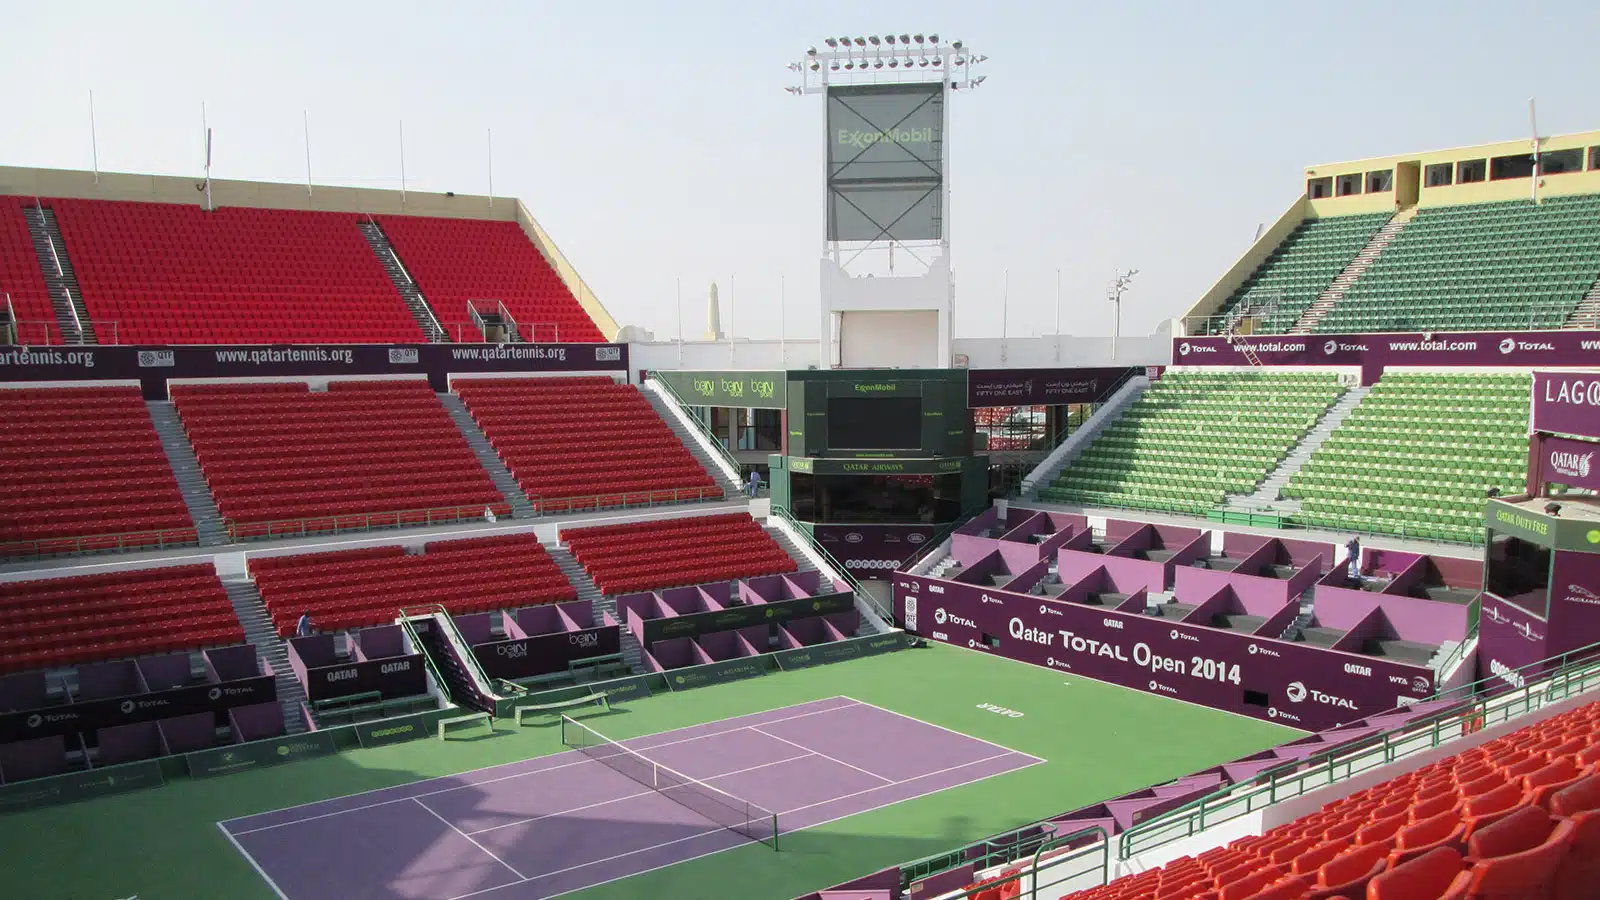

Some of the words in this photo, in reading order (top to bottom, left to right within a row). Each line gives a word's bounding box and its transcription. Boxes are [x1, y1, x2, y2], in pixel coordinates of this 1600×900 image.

[838, 127, 932, 151] ExxonMobil
[1233, 341, 1306, 352] www.total.com
[1338, 343, 1369, 351] TOTAL
[1388, 340, 1477, 351] www.total.com
[1517, 341, 1556, 351] TOTAL
[216, 347, 354, 365] www.qatartennis.org
[452, 346, 566, 362] www.qatartennis.org
[854, 383, 896, 393] ExxonMobil
[1550, 451, 1578, 470] QATAR
[843, 463, 869, 471] QATAR
[872, 463, 904, 471] AIRWAYS
[1496, 508, 1515, 525] QATAR
[1515, 514, 1532, 530] DUTY
[1532, 519, 1548, 536] FREE
[988, 597, 1004, 605] TOTAL
[1047, 608, 1063, 616] TOTAL
[948, 613, 977, 628] TOTAL
[1103, 617, 1124, 629] QATAR
[569, 632, 597, 645] beIN
[932, 630, 948, 641] QATAR
[1180, 632, 1200, 642] TOTAL
[496, 642, 527, 656] beIN
[1009, 616, 1055, 646] Qatar
[1058, 629, 1128, 662] TOTAL
[1133, 641, 1185, 674] Open
[1191, 656, 1242, 685] 2014
[1259, 647, 1281, 657] TOTAL
[381, 660, 410, 673] QATAR
[1055, 660, 1071, 668] TOTAL
[1344, 662, 1372, 677] QATAR
[327, 668, 358, 682] QATAR
[1389, 675, 1408, 685] WTA
[224, 686, 254, 695] TOTAL
[1158, 684, 1177, 693] TOTAL
[137, 699, 170, 709] TOTAL
[1310, 688, 1359, 710] TOTAL
[44, 712, 79, 722] TOTAL
[1278, 710, 1301, 721] TOTAL
